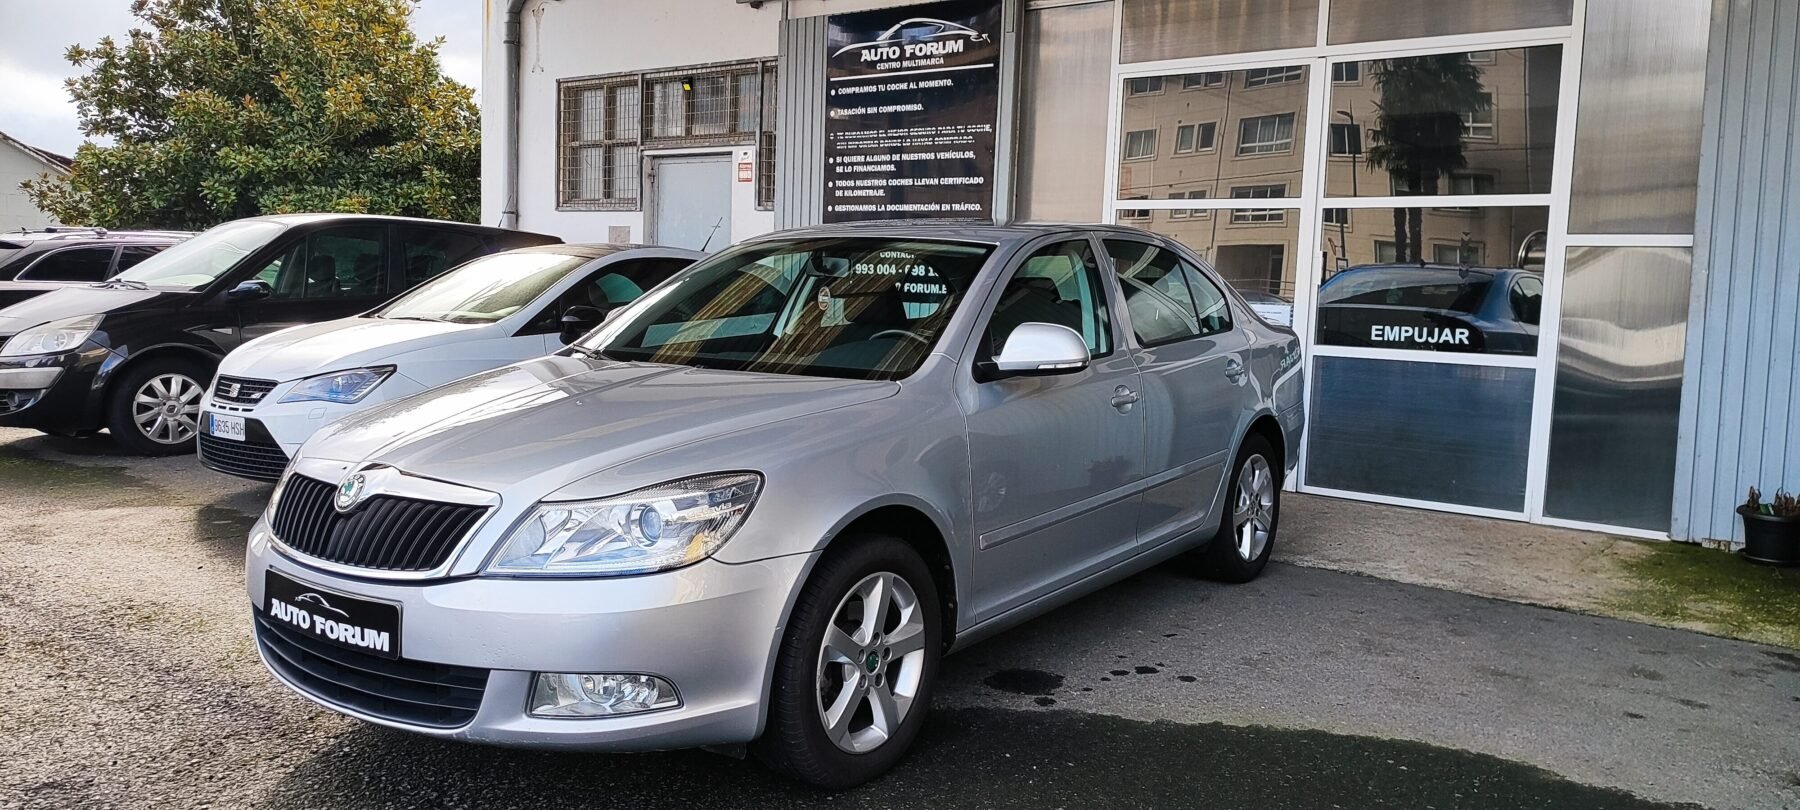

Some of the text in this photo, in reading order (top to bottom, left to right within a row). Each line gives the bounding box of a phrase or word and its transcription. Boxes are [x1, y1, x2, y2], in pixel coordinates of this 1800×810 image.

[860, 40, 964, 62] AUTO FORUM
[876, 58, 944, 70] CENTRO MULTIMARCA
[838, 85, 877, 94] COMPRAMOS
[887, 81, 908, 91] COCHE
[909, 81, 918, 89] AL
[919, 78, 954, 88] MOMENTO.
[837, 103, 924, 116] TASACIÓN SIN COMPROMISO.
[843, 155, 865, 164] QUIERE
[866, 154, 891, 162] ALGUNO
[902, 152, 935, 160] NUESTROS
[936, 150, 976, 159] VEHÍCULOS,
[853, 164, 896, 172] FINANCIAMOS.
[888, 178, 913, 186] COCHES
[914, 177, 938, 185] LLEVAN
[940, 176, 984, 184] CERTIFICADO
[835, 204, 876, 212] GESTIONAMOS
[886, 202, 940, 211] DOCUMENTACIÓN
[952, 201, 982, 211] TRÁFICO.
[855, 264, 874, 274] 993
[877, 264, 896, 275] 004
[1371, 325, 1469, 344] EMPUJAR
[231, 421, 244, 436] HSH
[270, 598, 390, 652] AUTO FORUM
